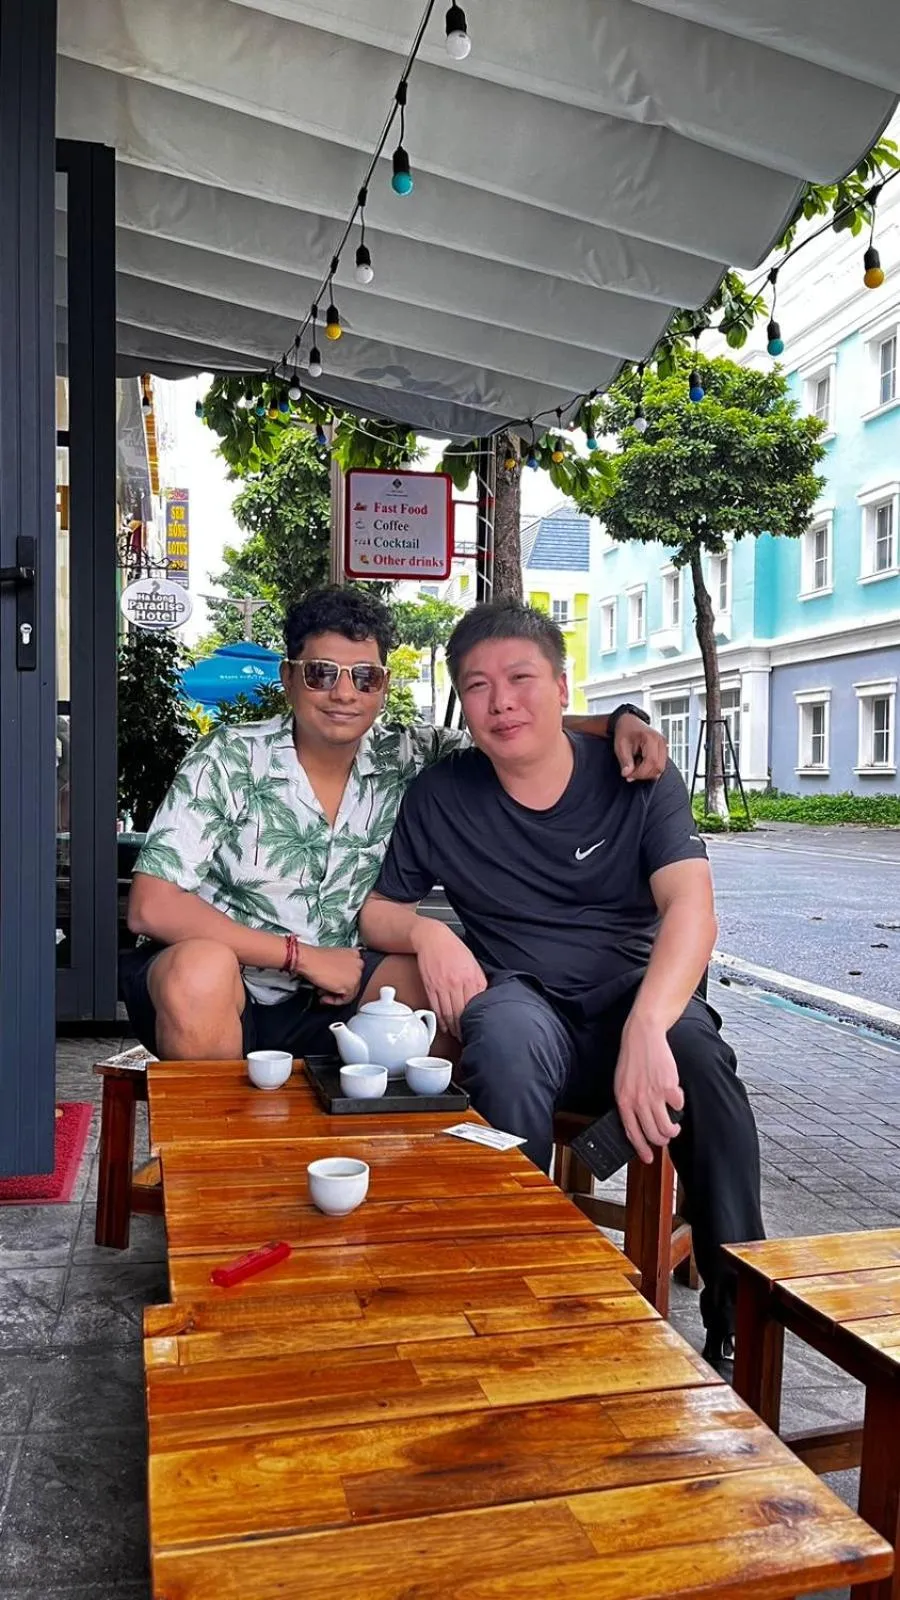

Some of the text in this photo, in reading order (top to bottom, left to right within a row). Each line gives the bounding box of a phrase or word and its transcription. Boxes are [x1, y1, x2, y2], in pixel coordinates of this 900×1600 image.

[374, 502, 428, 515] Fast Food
[373, 519, 409, 531] Coffee
[167, 541, 188, 555] LOTUS
[373, 537, 419, 549] Cocktail
[373, 554, 444, 567] Other drinks
[137, 593, 175, 602] Ha Long
[128, 600, 184, 611] Paradise
[135, 611, 176, 621] Hotel
